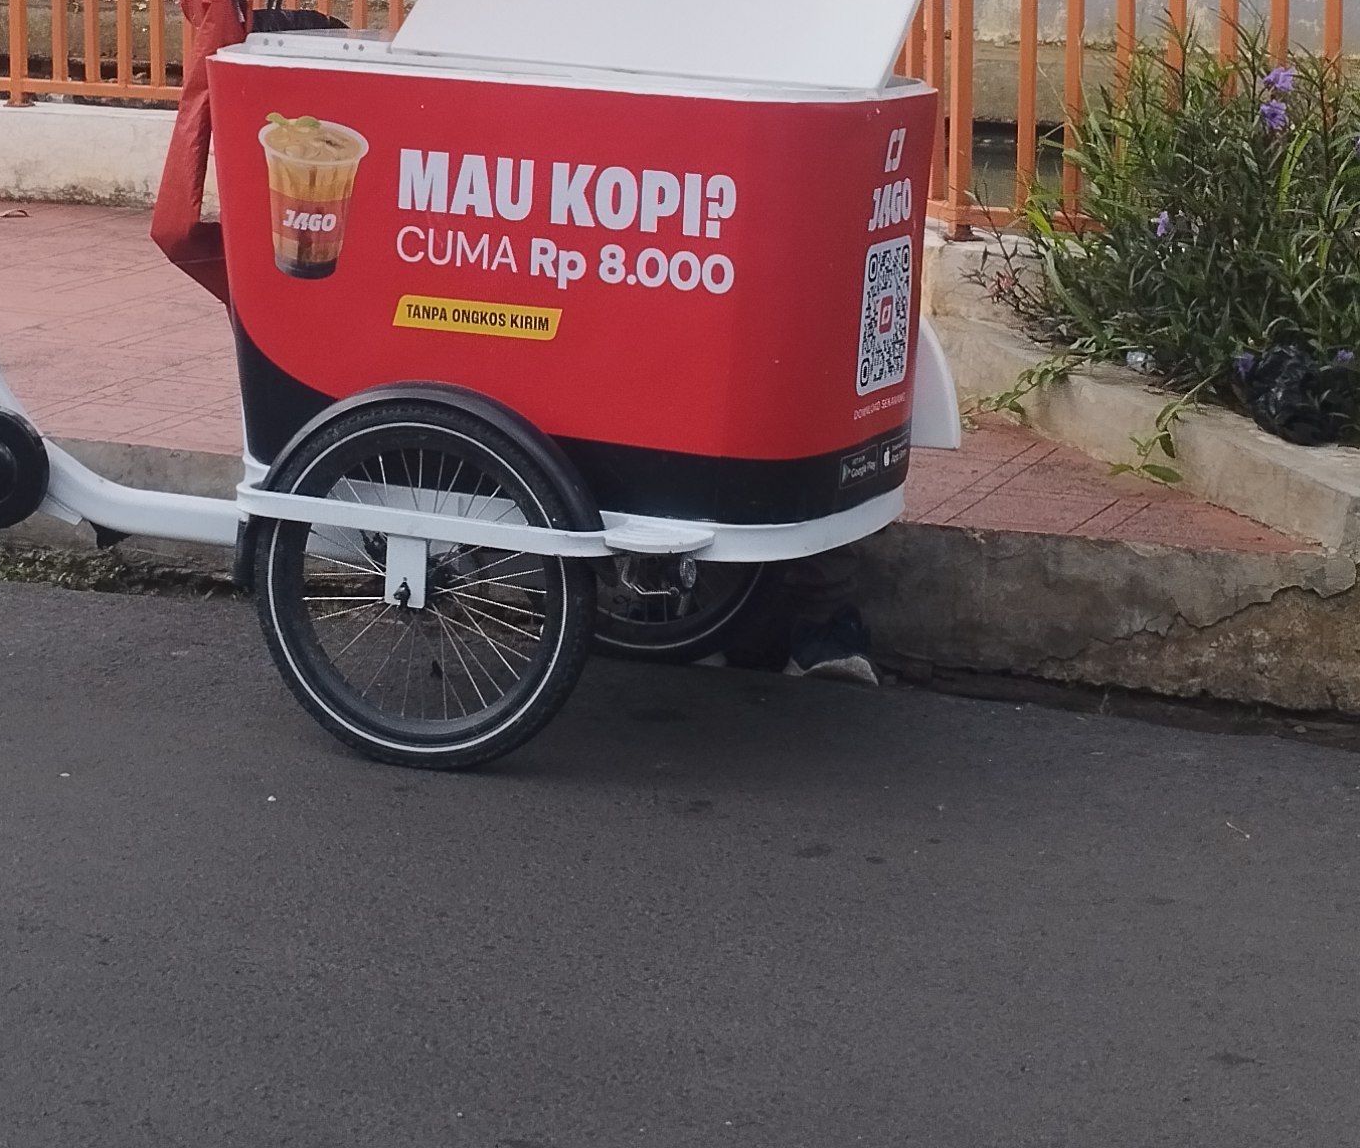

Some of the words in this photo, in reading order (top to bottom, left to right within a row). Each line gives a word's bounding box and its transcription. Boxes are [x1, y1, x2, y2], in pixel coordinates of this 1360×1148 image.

[282, 208, 337, 232] JAGO
[397, 148, 535, 222] MAU
[550, 161, 737, 239] KOPI?
[867, 177, 912, 232] JAGO
[395, 225, 519, 274] CUMA
[529, 236, 587, 290] Rp
[598, 243, 736, 295] 8.000
[405, 303, 449, 323] TANPA
[451, 308, 507, 328] ONGKOS
[509, 313, 550, 332] KIRIM
